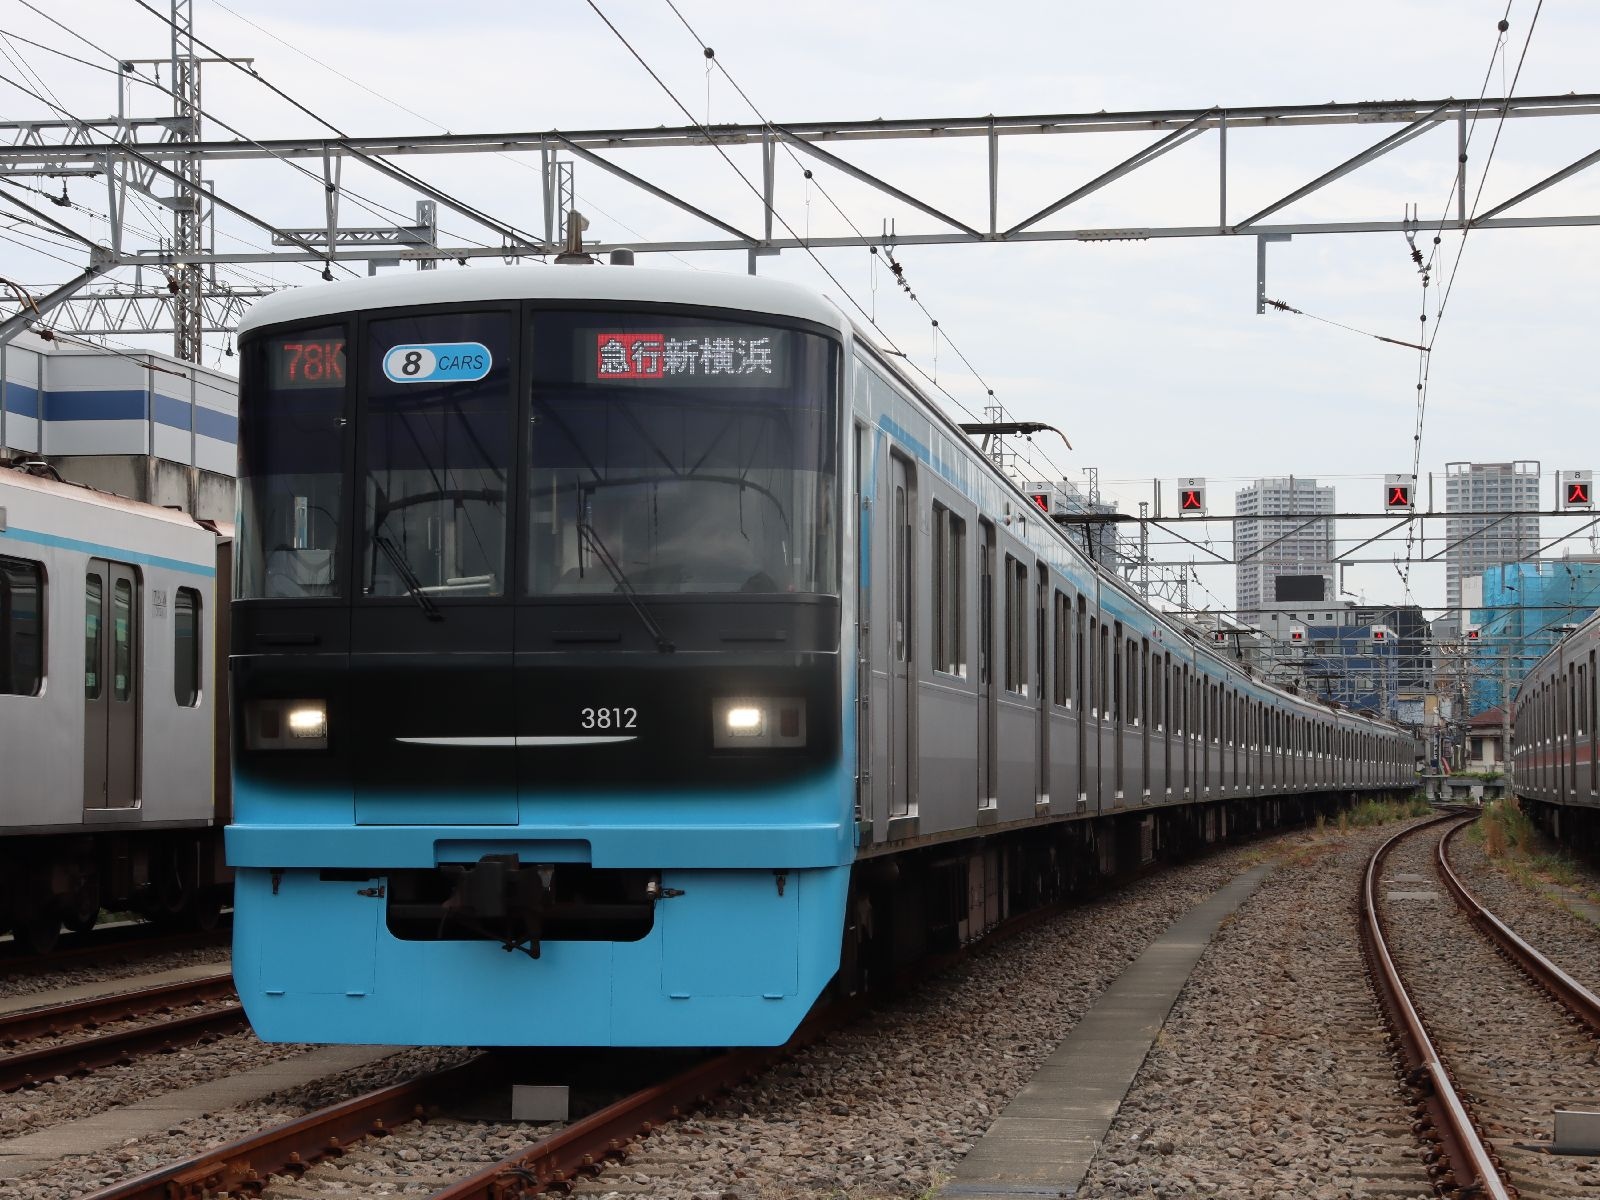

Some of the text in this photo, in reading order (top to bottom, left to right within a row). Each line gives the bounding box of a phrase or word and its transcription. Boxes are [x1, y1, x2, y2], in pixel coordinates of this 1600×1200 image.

[283, 342, 344, 382] 78K
[402, 351, 484, 376] 8 CARS
[581, 707, 637, 729] 3812
